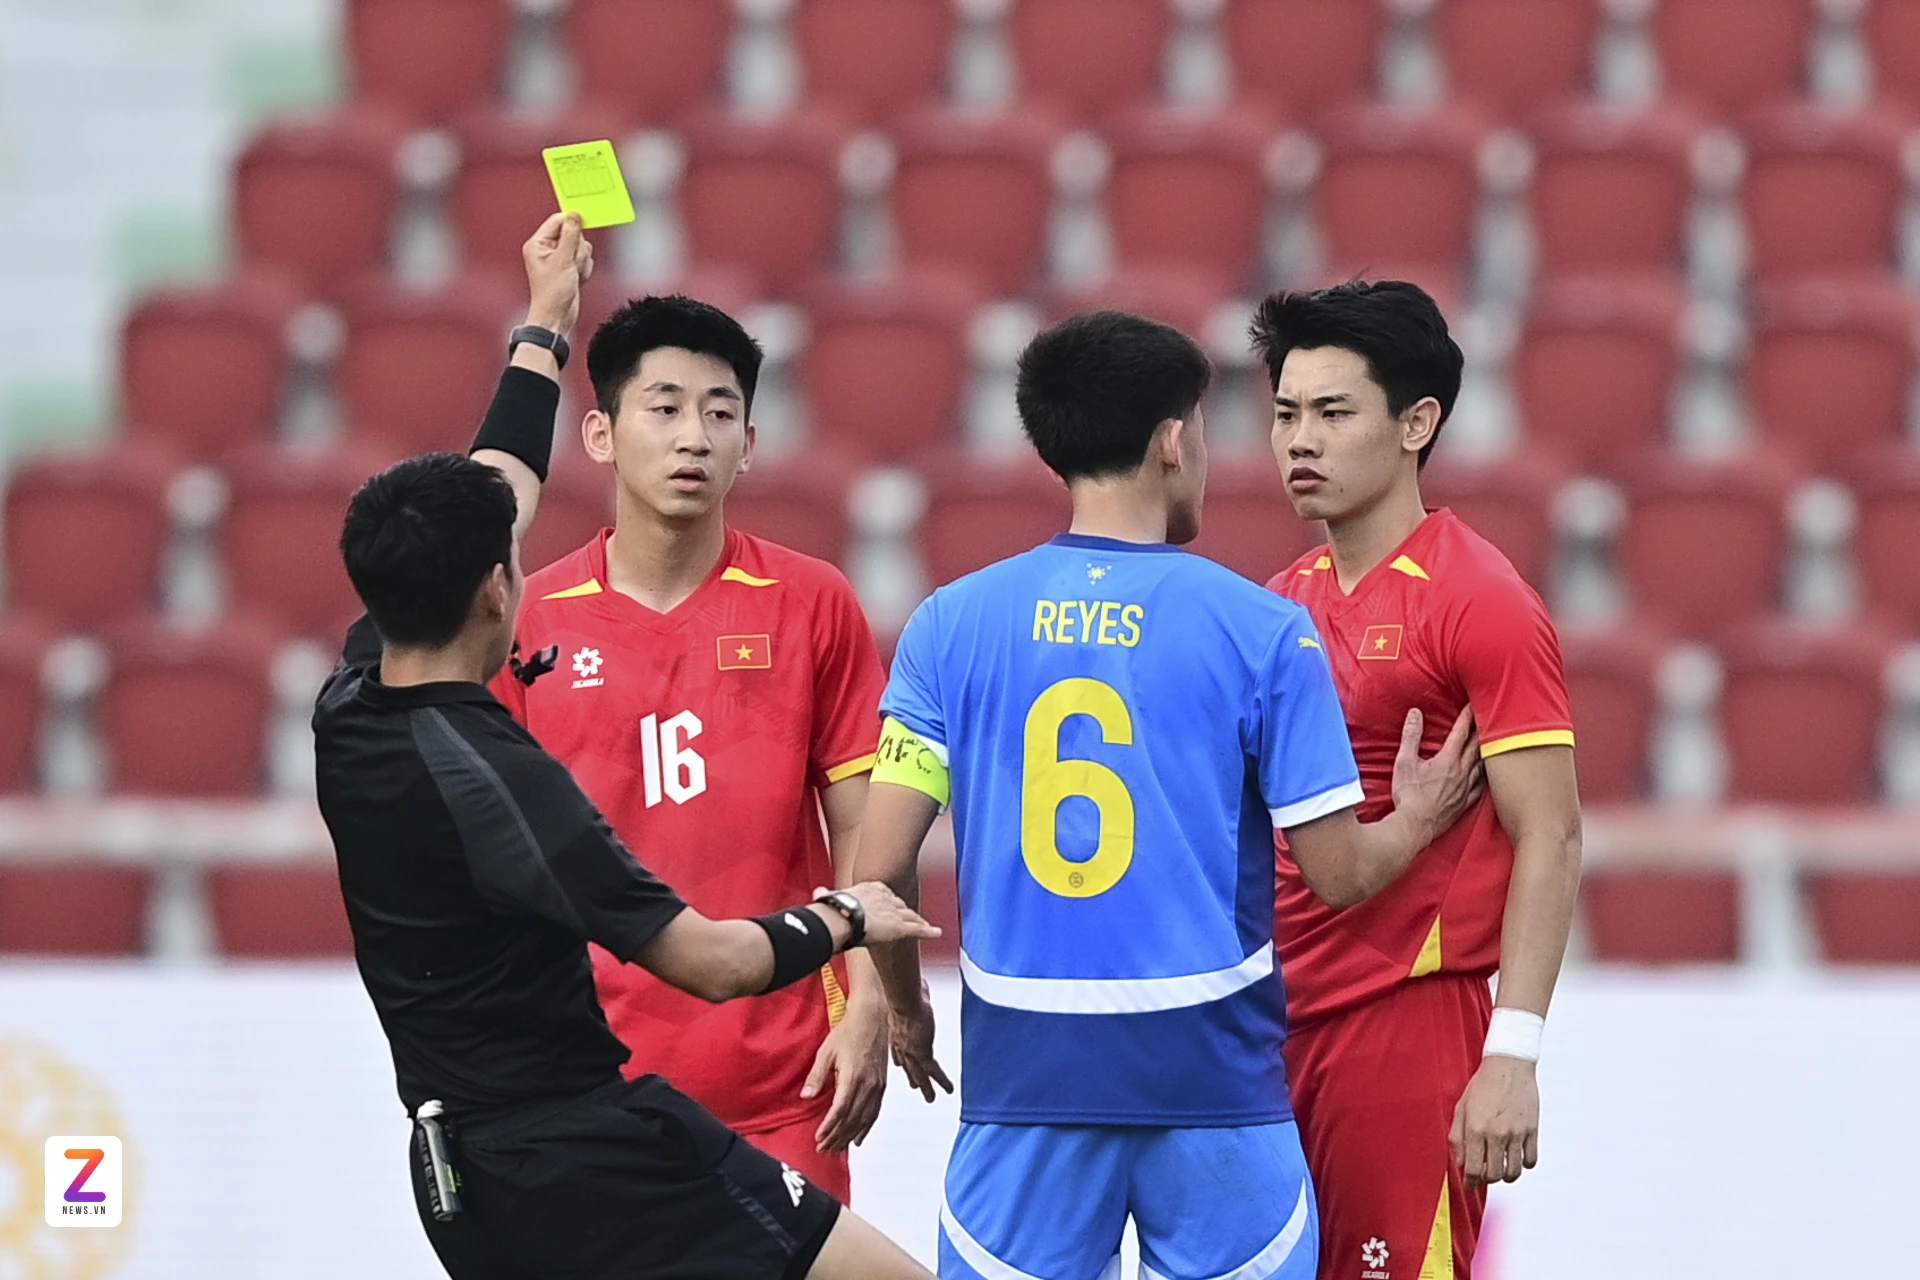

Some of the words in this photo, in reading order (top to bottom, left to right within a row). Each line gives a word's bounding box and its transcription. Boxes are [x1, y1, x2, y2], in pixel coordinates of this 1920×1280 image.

[1032, 600, 1144, 648] REYES
[640, 709, 708, 809] 16
[1021, 677, 1135, 898] 6
